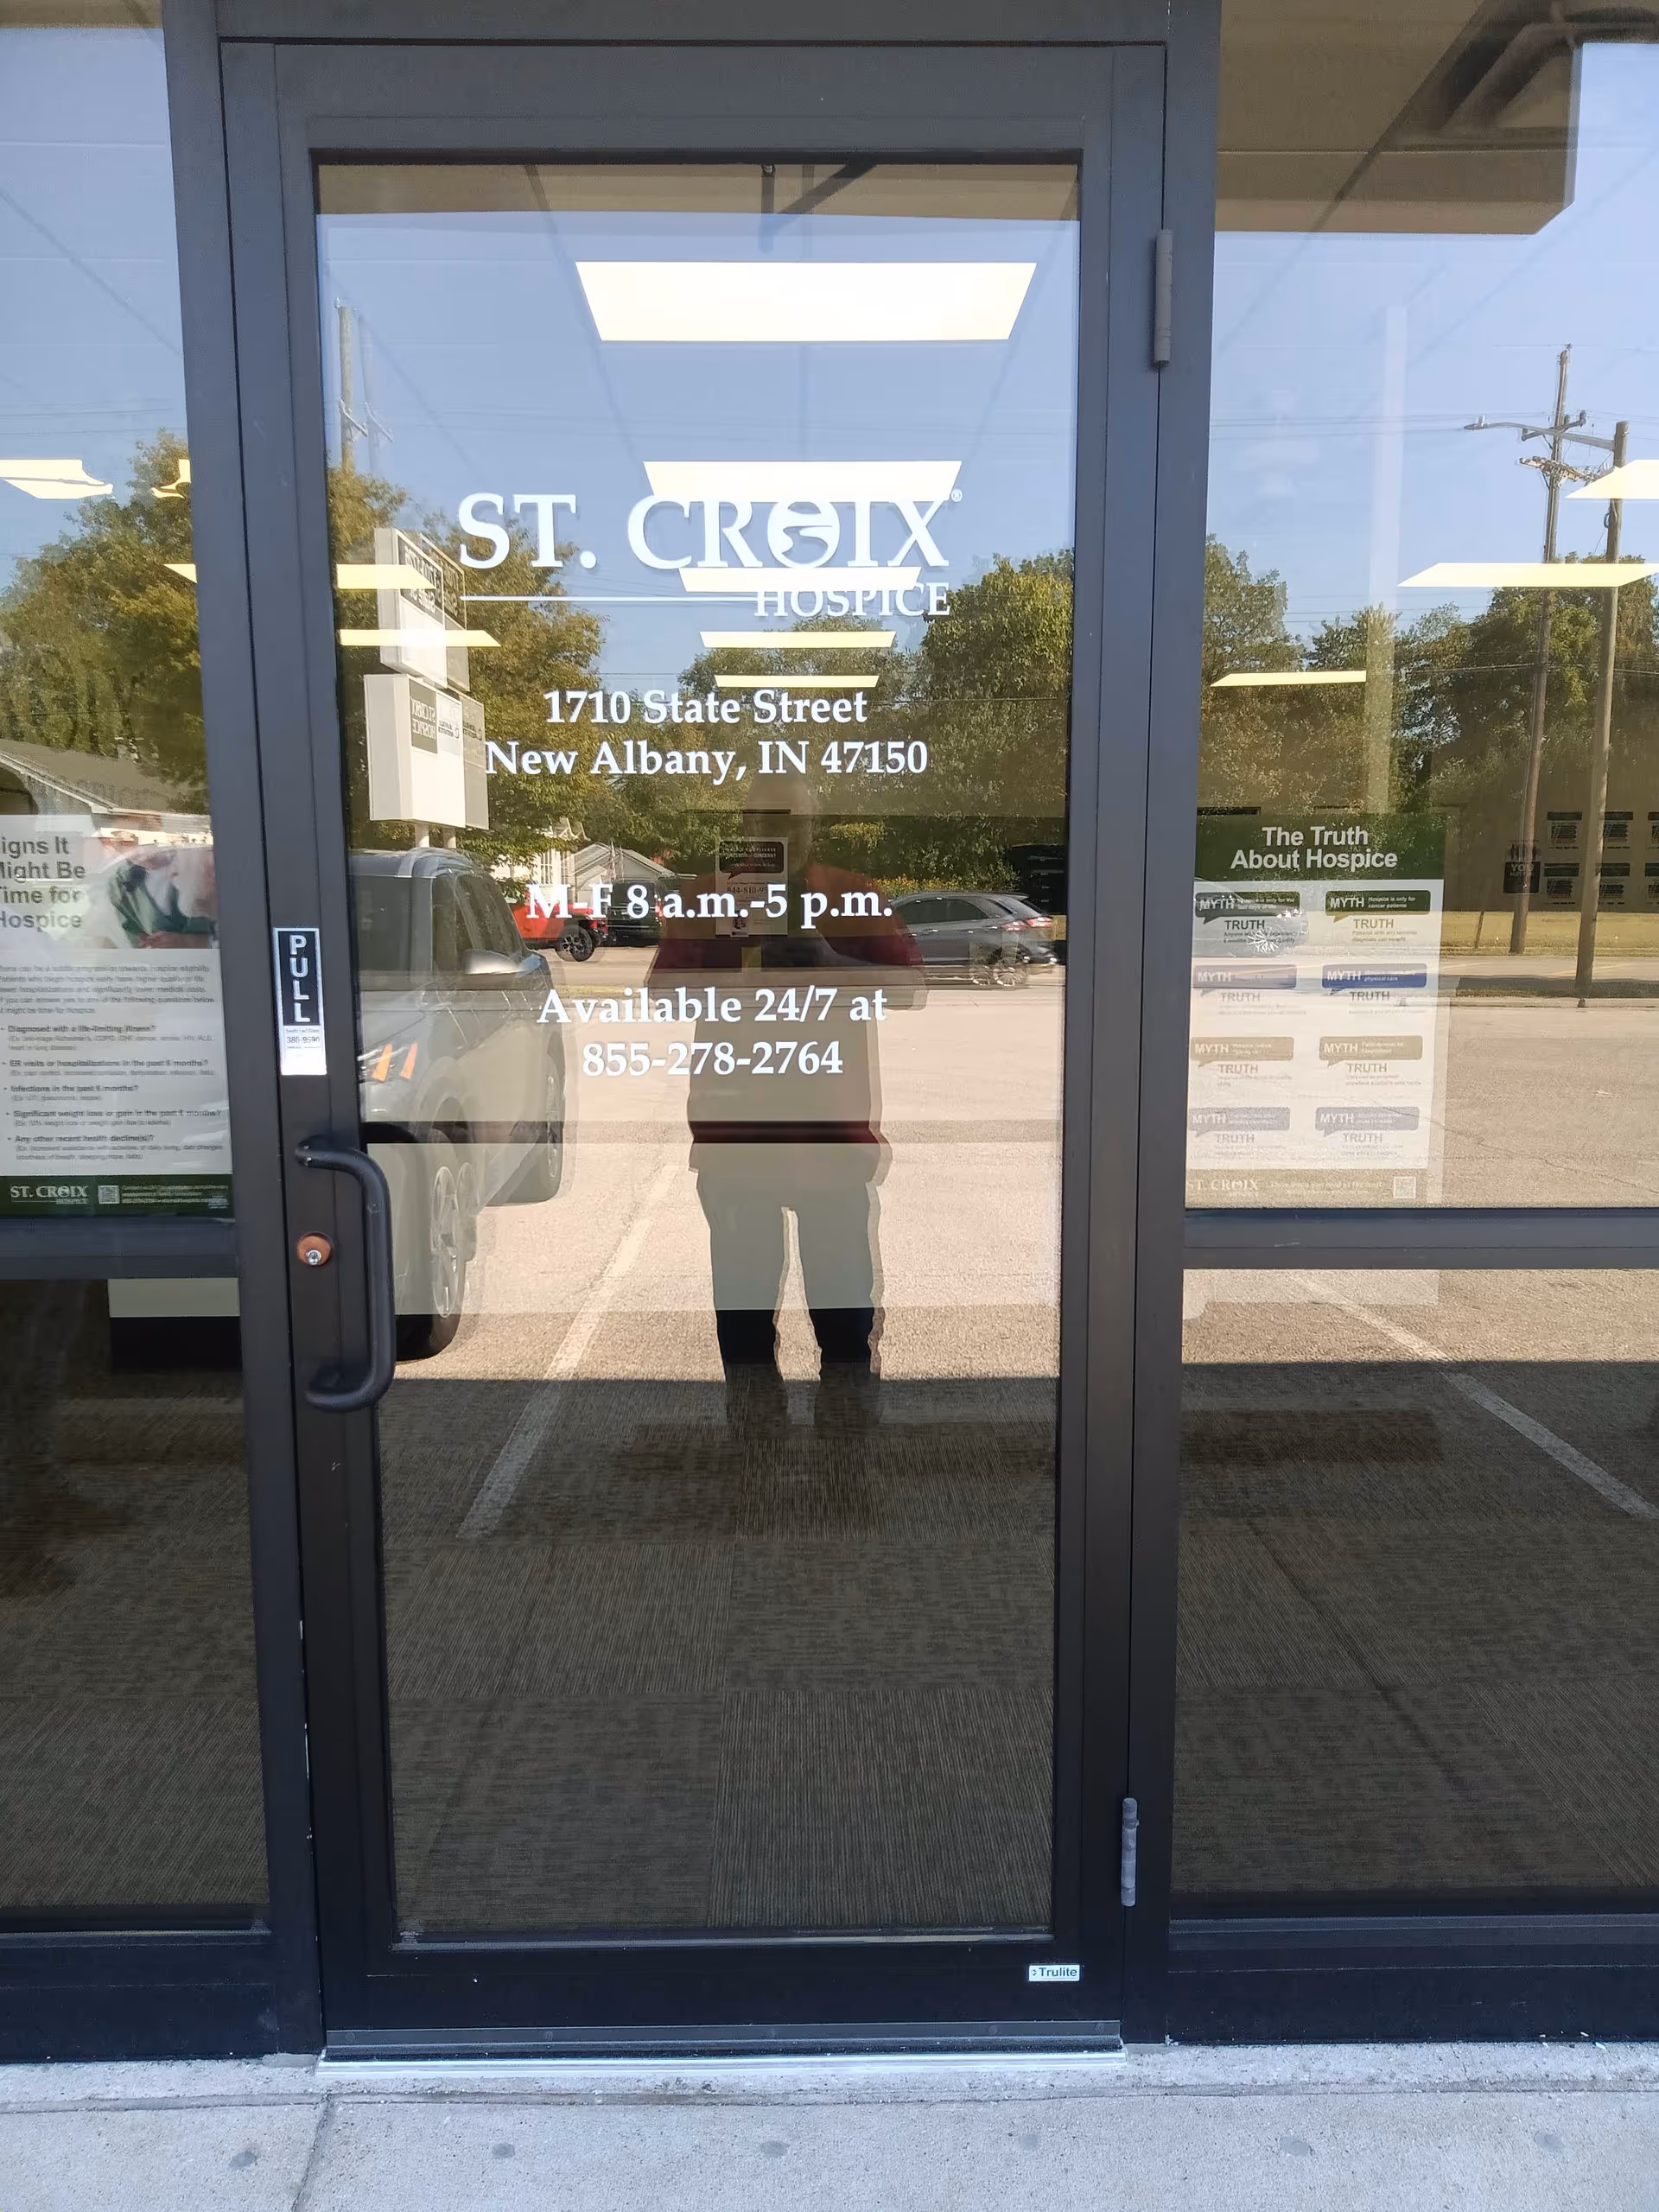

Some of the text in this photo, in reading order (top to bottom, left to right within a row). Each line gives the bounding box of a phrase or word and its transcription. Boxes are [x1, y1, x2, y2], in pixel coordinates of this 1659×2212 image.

[457, 493, 597, 569] ST.
[627, 493, 950, 569] CROIX
[754, 582, 950, 617] HOSPICE
[543, 689, 868, 724] 1710 State Street
[485, 739, 929, 785] New Albany, IN 47150
[1262, 826, 1368, 846] The Truth
[0, 836, 70, 859] igns It
[1230, 849, 1398, 873] About Hospice
[56, 861, 86, 879] Be
[0, 886, 82, 904] ime for
[526, 882, 893, 930] M-F 8 a.m.-5 p.m.
[1200, 898, 1235, 910] MYTH
[1331, 897, 1364, 908] MYTH
[1224, 920, 1265, 931] TRUTH
[1353, 918, 1395, 929] TRUTH
[289, 934, 311, 1023] PULL
[1198, 972, 1232, 982] MYTH
[1327, 970, 1362, 981] MYTH
[1221, 992, 1261, 1002] TRUTH
[1350, 991, 1390, 1001] TRUTH
[537, 984, 888, 1023] Available 24/7 at
[1195, 1044, 1229, 1053] MYTH
[1325, 1043, 1358, 1052] MYTH
[582, 1040, 844, 1077] 855-278-2764
[1218, 1064, 1258, 1074] TRUTH
[1348, 1063, 1388, 1073] TRUTH
[1320, 1113, 1354, 1123] MYTH
[1343, 1133, 1382, 1142] TRUTH
[1210, 1179, 1260, 1191] CROIX
[10, 1185, 88, 1198] ST. CROIX
[1039, 1967, 1077, 1977] Trulite
